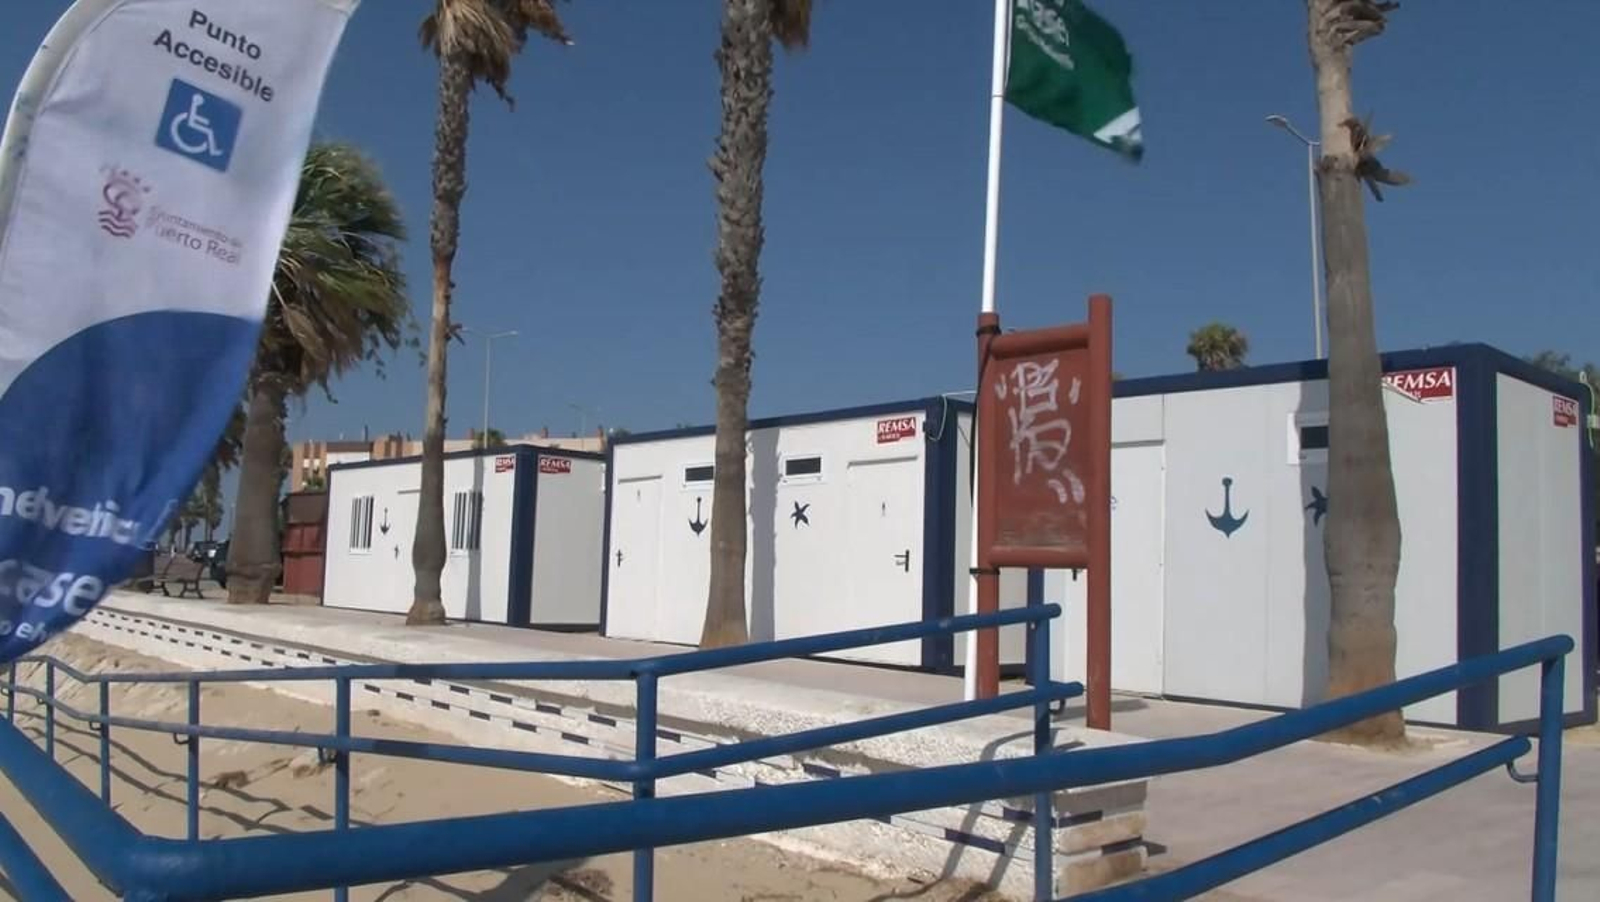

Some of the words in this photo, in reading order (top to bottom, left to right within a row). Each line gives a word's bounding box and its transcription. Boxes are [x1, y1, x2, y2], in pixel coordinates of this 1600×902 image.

[189, 9, 263, 60] Punto
[154, 28, 275, 103] Accesible
[878, 417, 916, 434] REMSA
